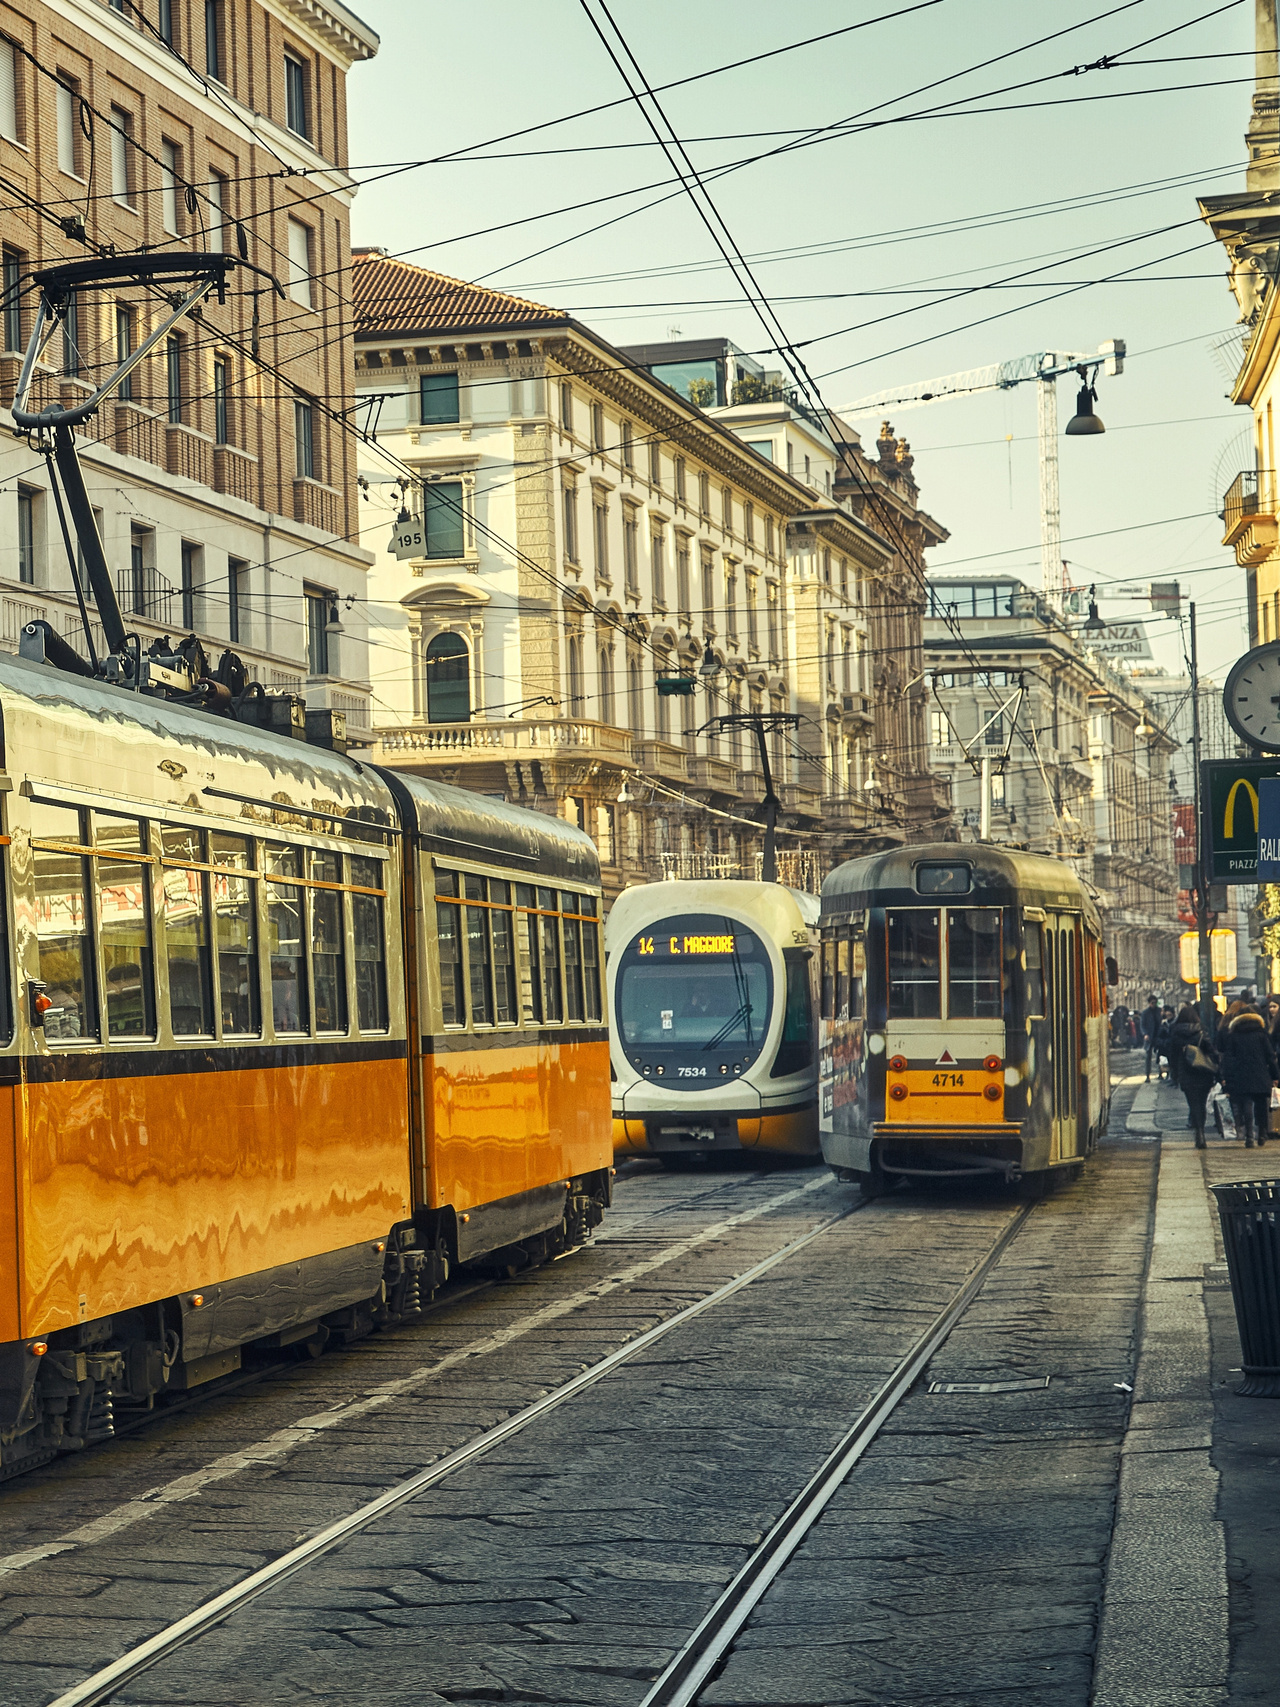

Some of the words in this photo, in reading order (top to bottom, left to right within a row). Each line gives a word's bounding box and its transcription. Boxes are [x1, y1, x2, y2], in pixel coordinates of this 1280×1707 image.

[397, 532, 421, 548] 195
[638, 937, 655, 955] 14
[683, 935, 734, 953] MAGGIORE
[677, 1067, 707, 1077] 7534
[932, 1074, 964, 1086] 4714
